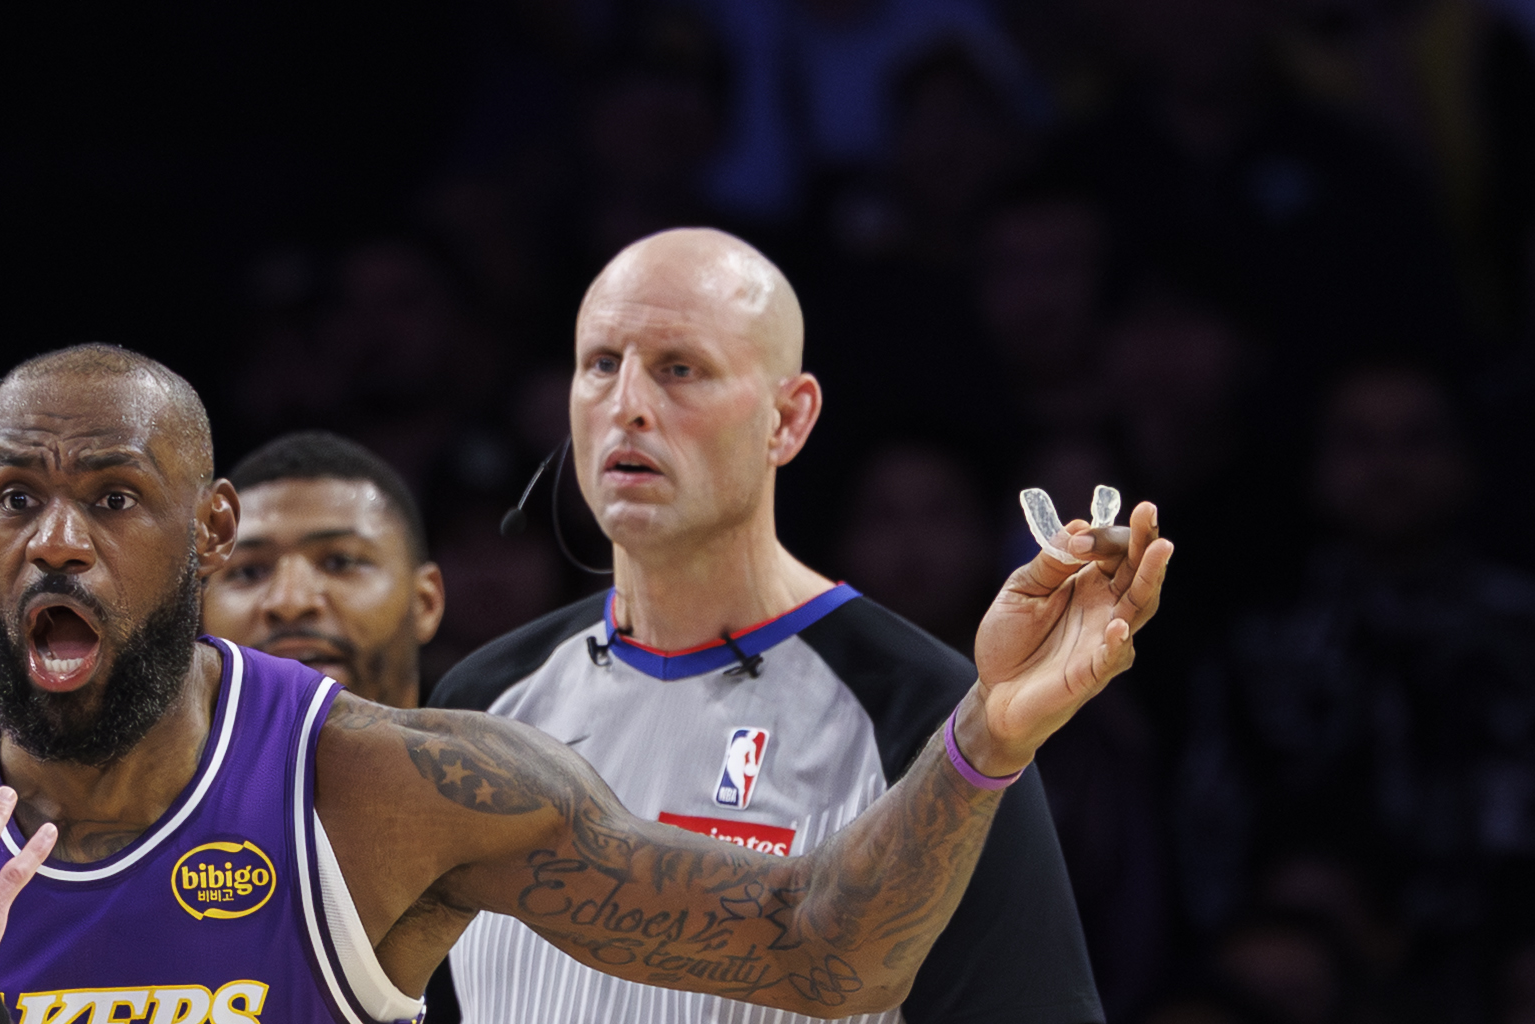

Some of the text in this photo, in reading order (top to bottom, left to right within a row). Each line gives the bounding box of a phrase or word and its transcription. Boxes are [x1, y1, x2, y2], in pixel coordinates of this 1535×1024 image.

[718, 787, 737, 803] NBA
[181, 862, 269, 895] bibigo
[197, 889, 234, 902] 비비고
